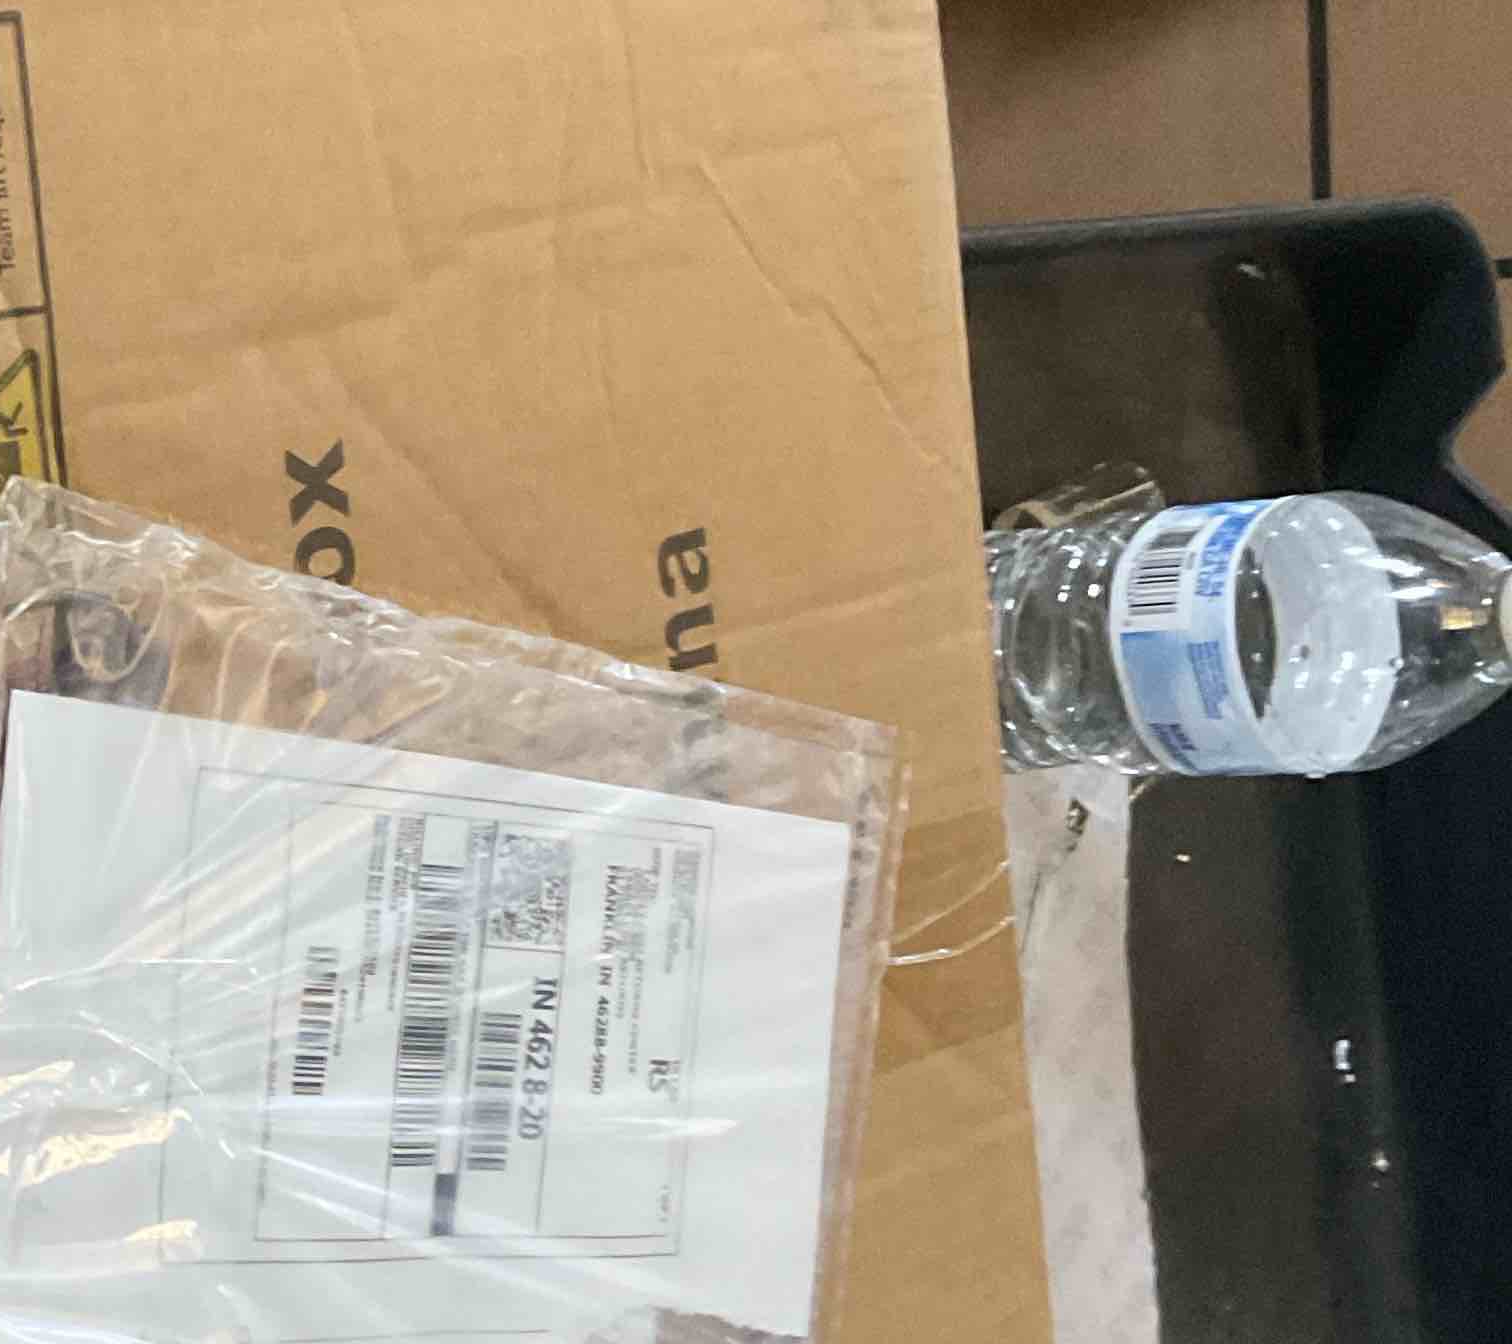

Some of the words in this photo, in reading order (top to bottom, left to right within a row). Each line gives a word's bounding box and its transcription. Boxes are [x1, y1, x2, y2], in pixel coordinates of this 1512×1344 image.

[531, 976, 559, 1011] IN
[598, 965, 614, 987] IN
[524, 1018, 554, 1071] 462
[648, 1058, 671, 1094] RS
